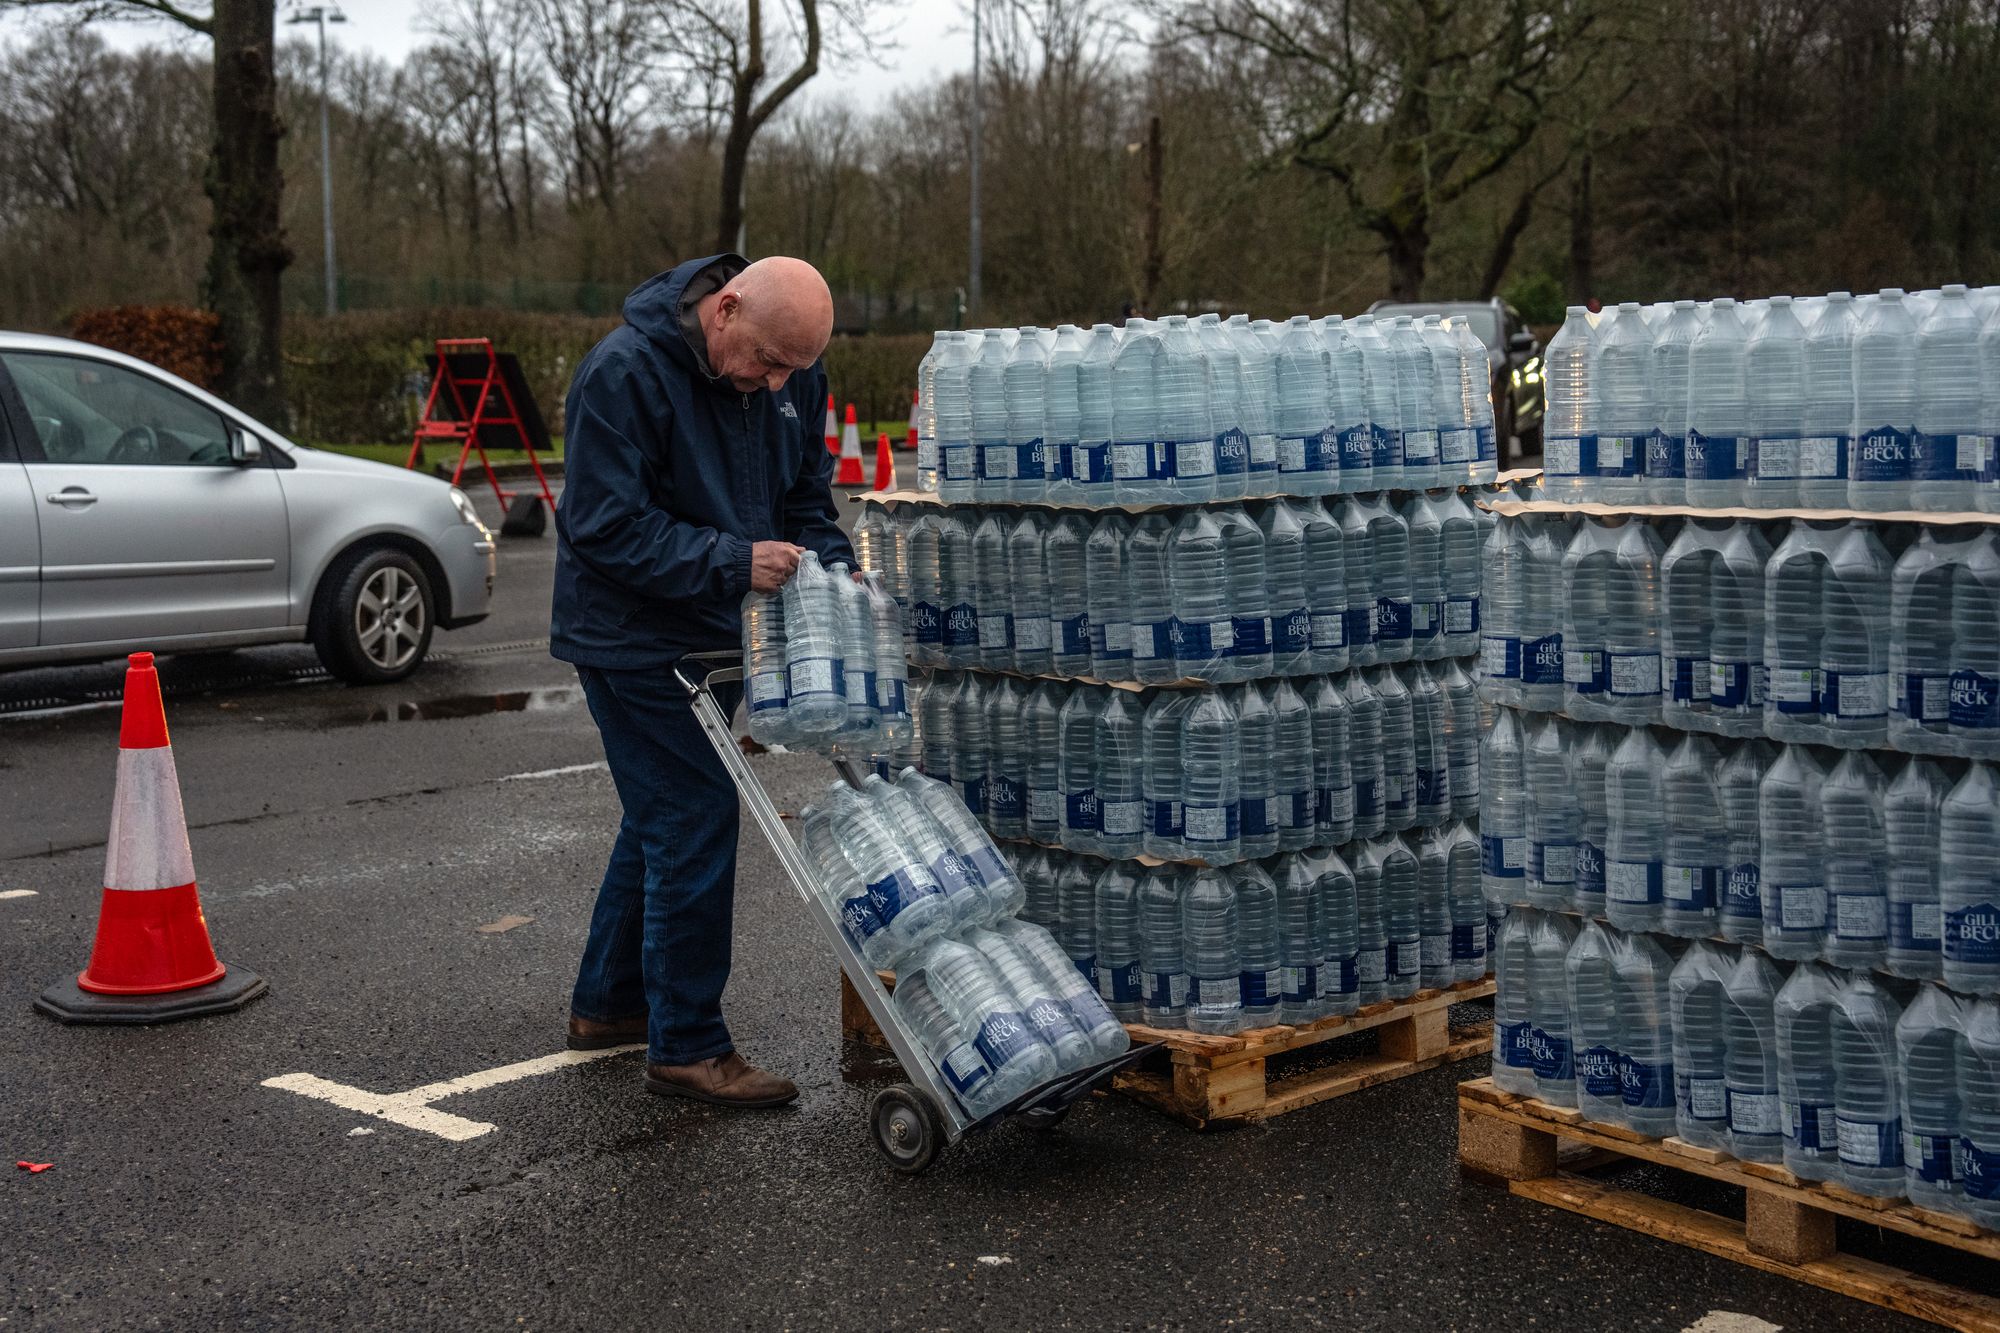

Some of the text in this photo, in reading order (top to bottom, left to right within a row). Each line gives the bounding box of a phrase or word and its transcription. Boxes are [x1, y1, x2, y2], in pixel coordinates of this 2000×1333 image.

[1224, 436, 1243, 446] GILL
[1868, 435, 1899, 447] GILL
[1863, 446, 1905, 462] BECK
[950, 611, 973, 620] GILL
[1378, 605, 1394, 614] ILL
[948, 619, 978, 632] BECK
[1535, 652, 1563, 667] BEC
[1953, 679, 1982, 691] GILL
[1950, 689, 1989, 707] BECK
[990, 791, 1017, 804] BECK
[1577, 848, 1595, 860] ILL
[1577, 858, 1601, 874] ECK
[1964, 913, 2000, 926] GILL
[1030, 1003, 1054, 1021] GILL
[1032, 1007, 1064, 1031] BECK
[985, 1017, 1010, 1036] GILL
[986, 1021, 1021, 1048] BECK
[1533, 1047, 1556, 1061] ECK
[1585, 1054, 1613, 1065] GILL
[1582, 1063, 1620, 1078] BECK
[1620, 1073, 1642, 1088] ECK
